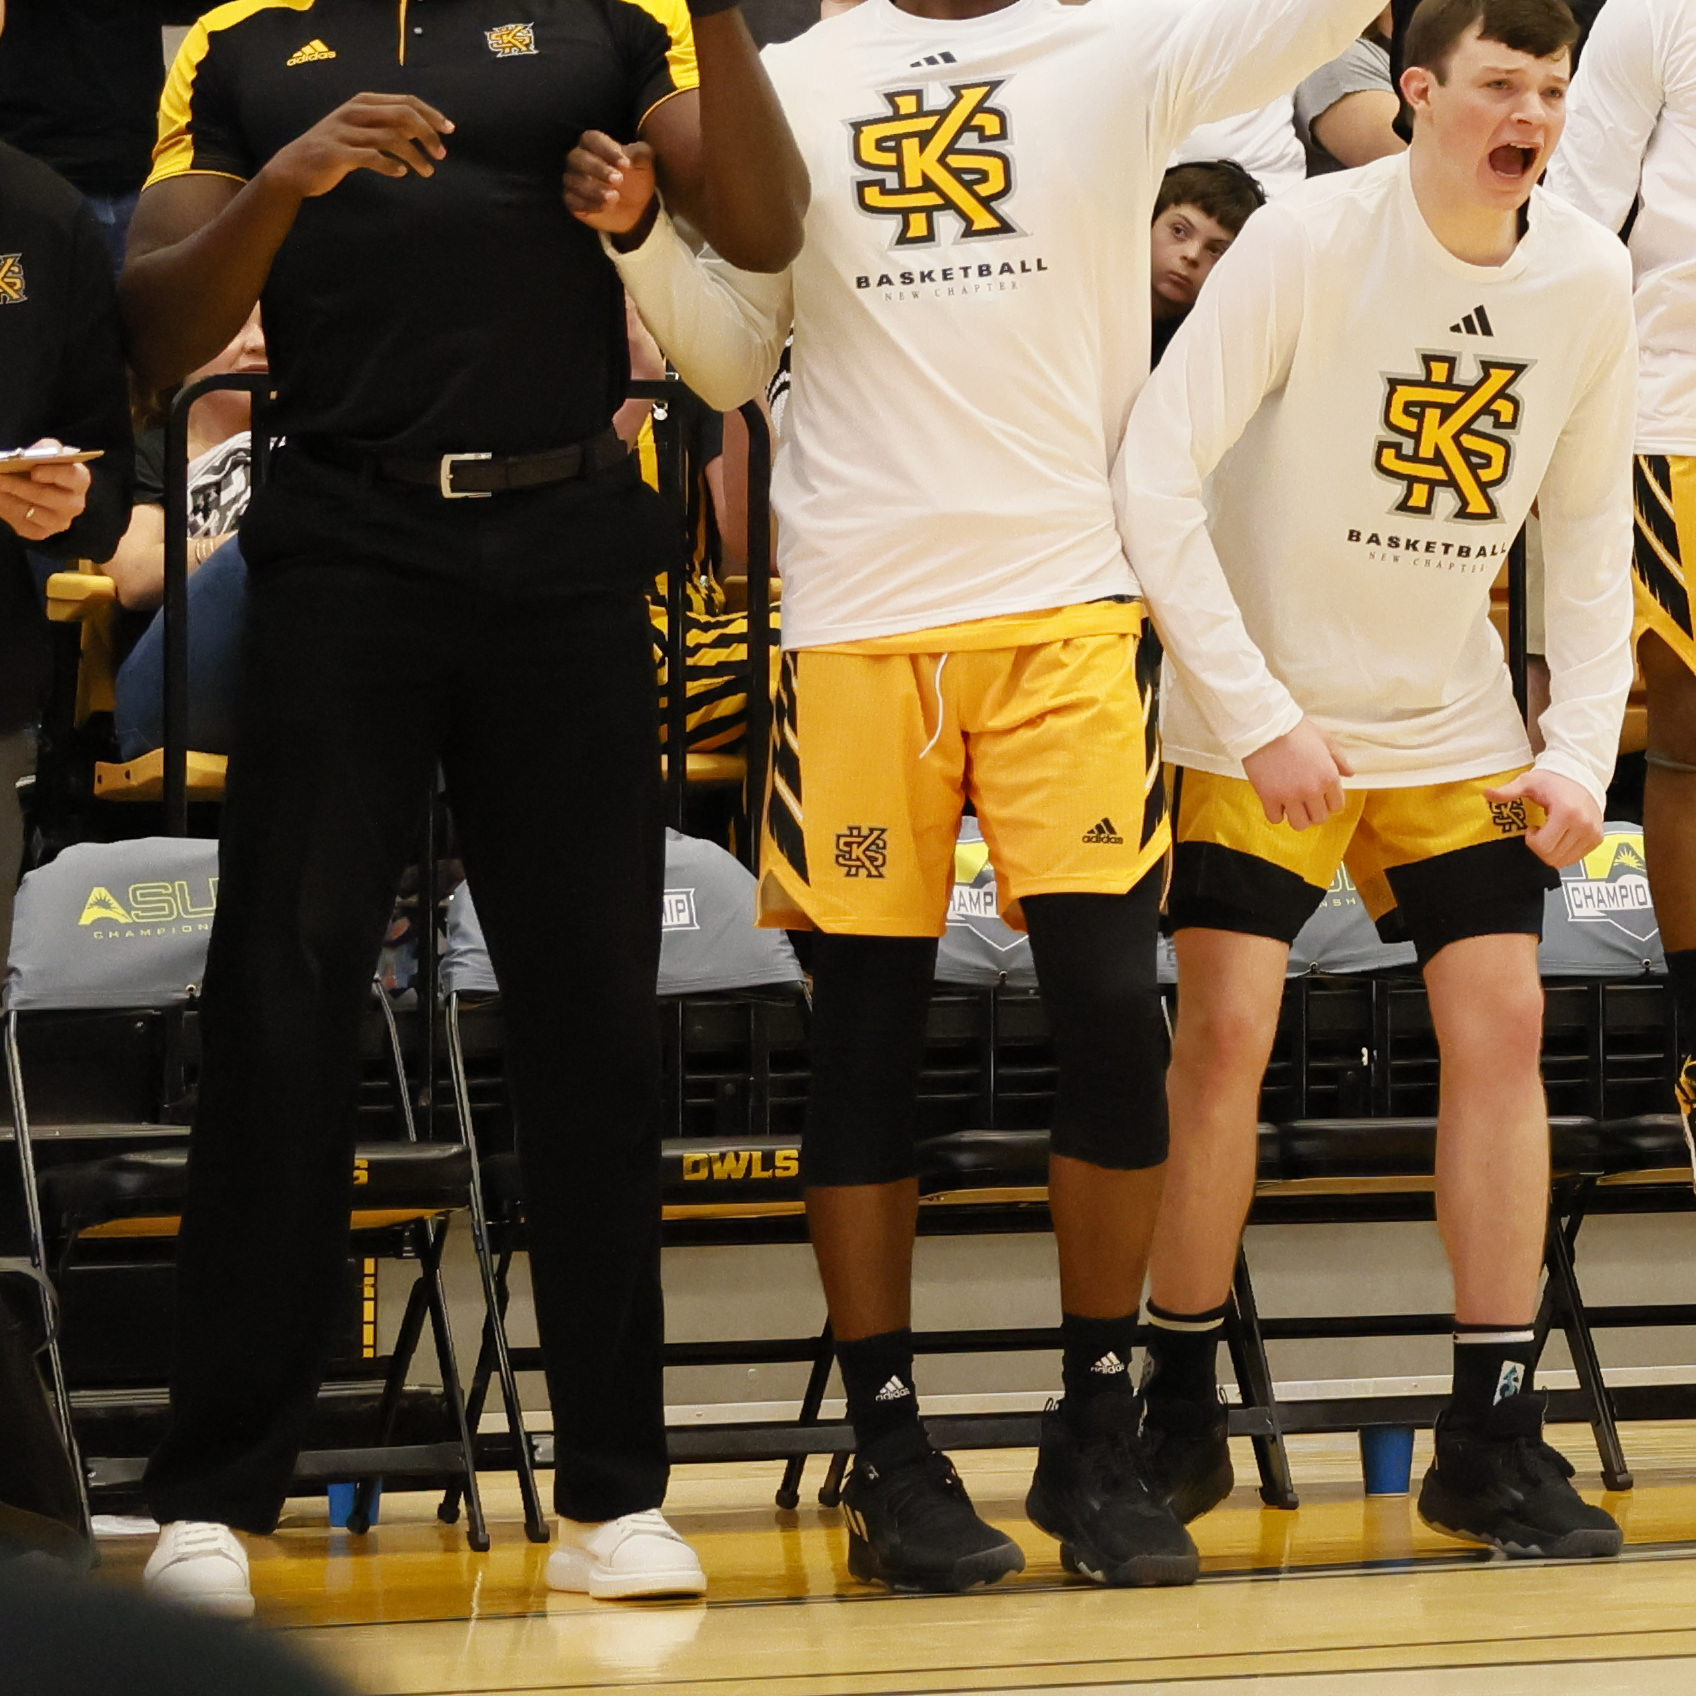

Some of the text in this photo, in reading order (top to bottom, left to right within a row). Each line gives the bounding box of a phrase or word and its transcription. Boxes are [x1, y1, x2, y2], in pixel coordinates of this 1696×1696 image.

[286, 50, 337, 67] adidas
[857, 257, 1049, 290] BASKETBALL
[885, 280, 1020, 303] NEW CHAPTER
[1347, 528, 1508, 559] BASKETBALL
[1368, 551, 1402, 564] NEW
[1082, 834, 1124, 845] adidas
[1571, 882, 1648, 911] CHAMPIO
[94, 922, 212, 941] CHAMPION
[682, 1148, 801, 1182] OWLS
[1090, 1362, 1125, 1375] adidas
[875, 1387, 911, 1402] adidas
